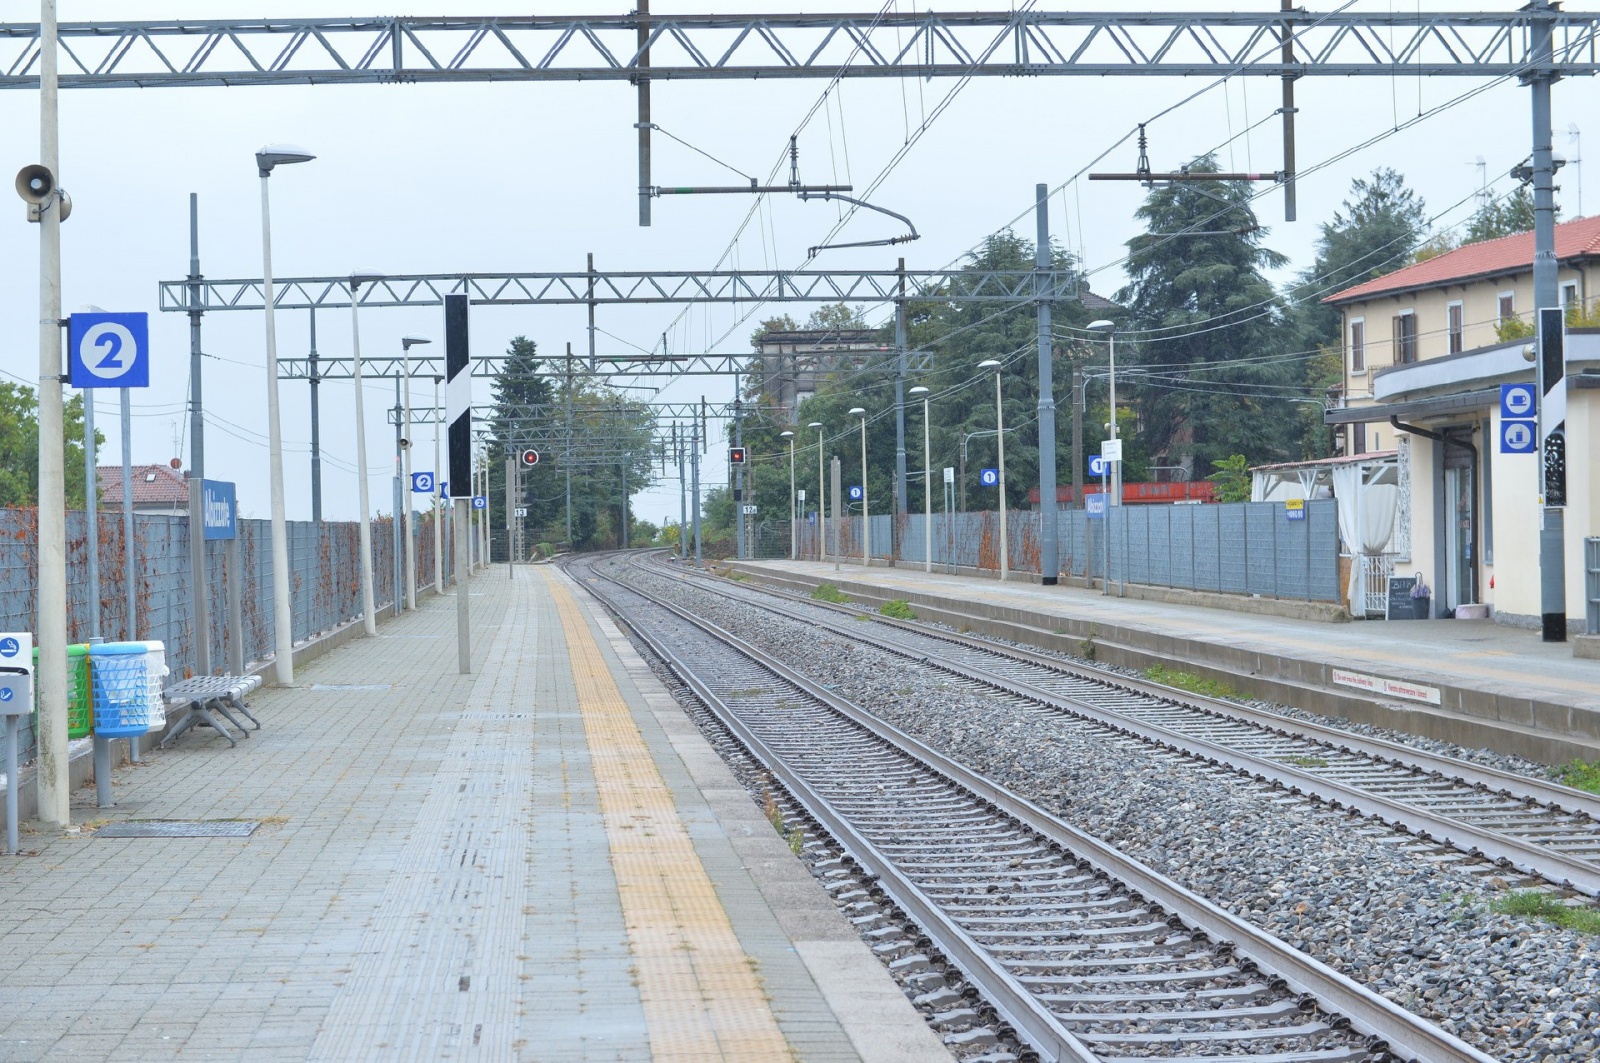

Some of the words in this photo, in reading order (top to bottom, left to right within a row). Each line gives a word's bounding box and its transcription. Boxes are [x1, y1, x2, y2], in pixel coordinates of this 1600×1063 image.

[94, 332, 122, 368] 2
[1096, 460, 1101, 471] 1
[420, 478, 428, 487] 2
[988, 474, 991, 482] 1
[1391, 580, 1411, 589] BAR
